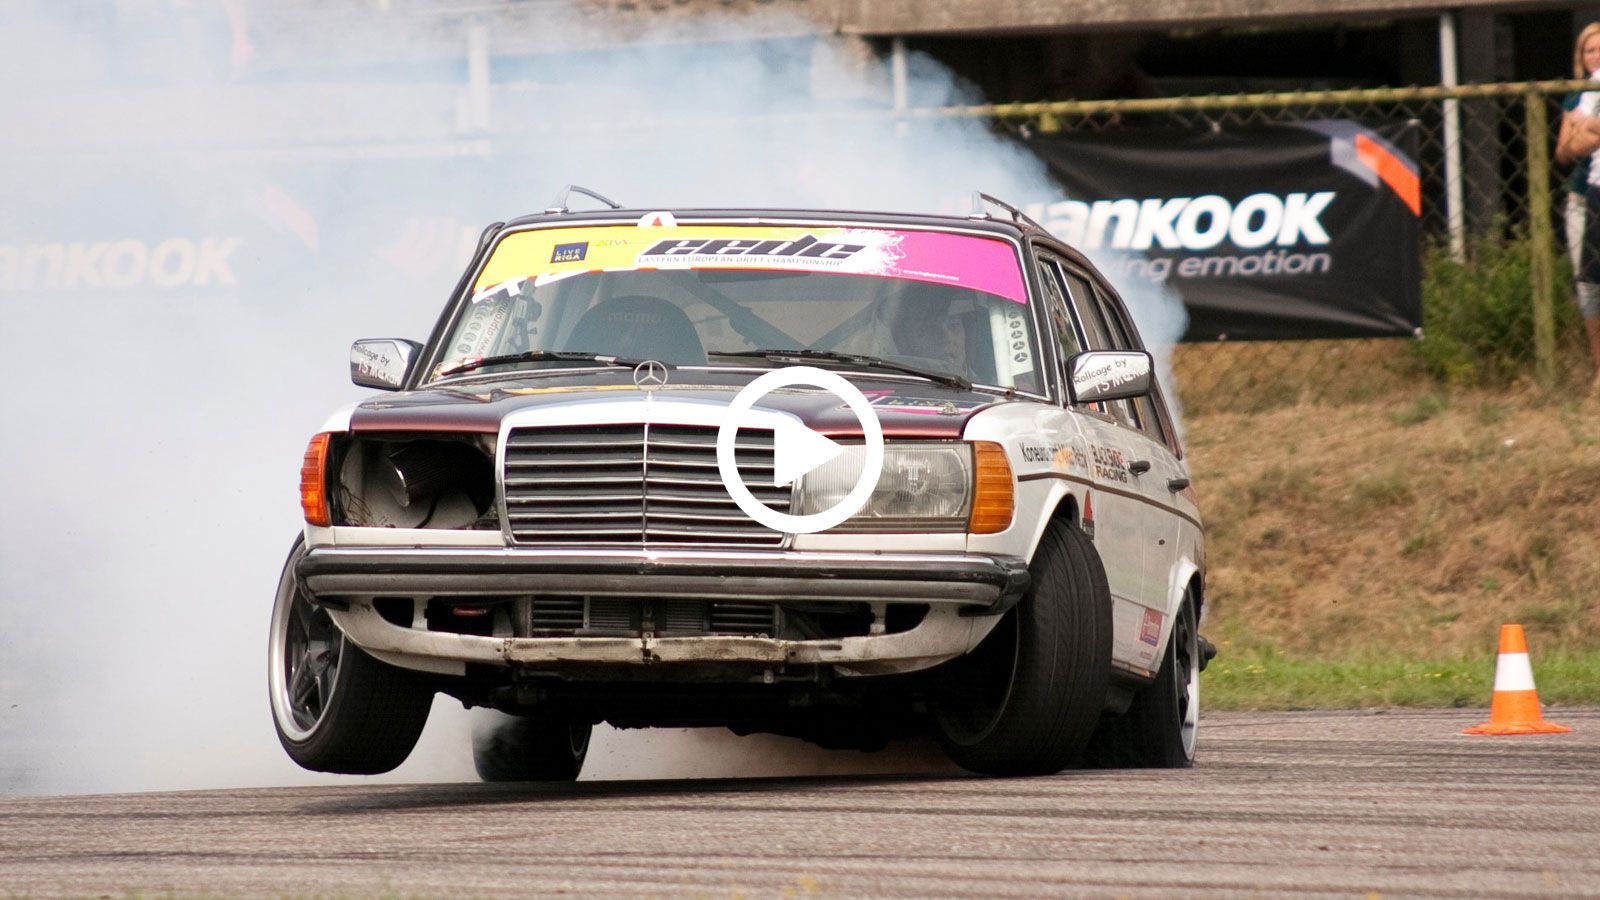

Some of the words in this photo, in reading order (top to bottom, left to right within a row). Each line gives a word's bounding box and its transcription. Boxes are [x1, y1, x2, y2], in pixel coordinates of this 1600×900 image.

[554, 254, 580, 262] RIGA
[686, 255, 734, 263] EUROPEAN
[767, 257, 844, 267] CHAMPIONSHIP
[1177, 250, 1332, 278] emotion
[1073, 364, 1113, 385] Rollcage
[1114, 359, 1127, 369] by
[1095, 465, 1128, 484] RACING
